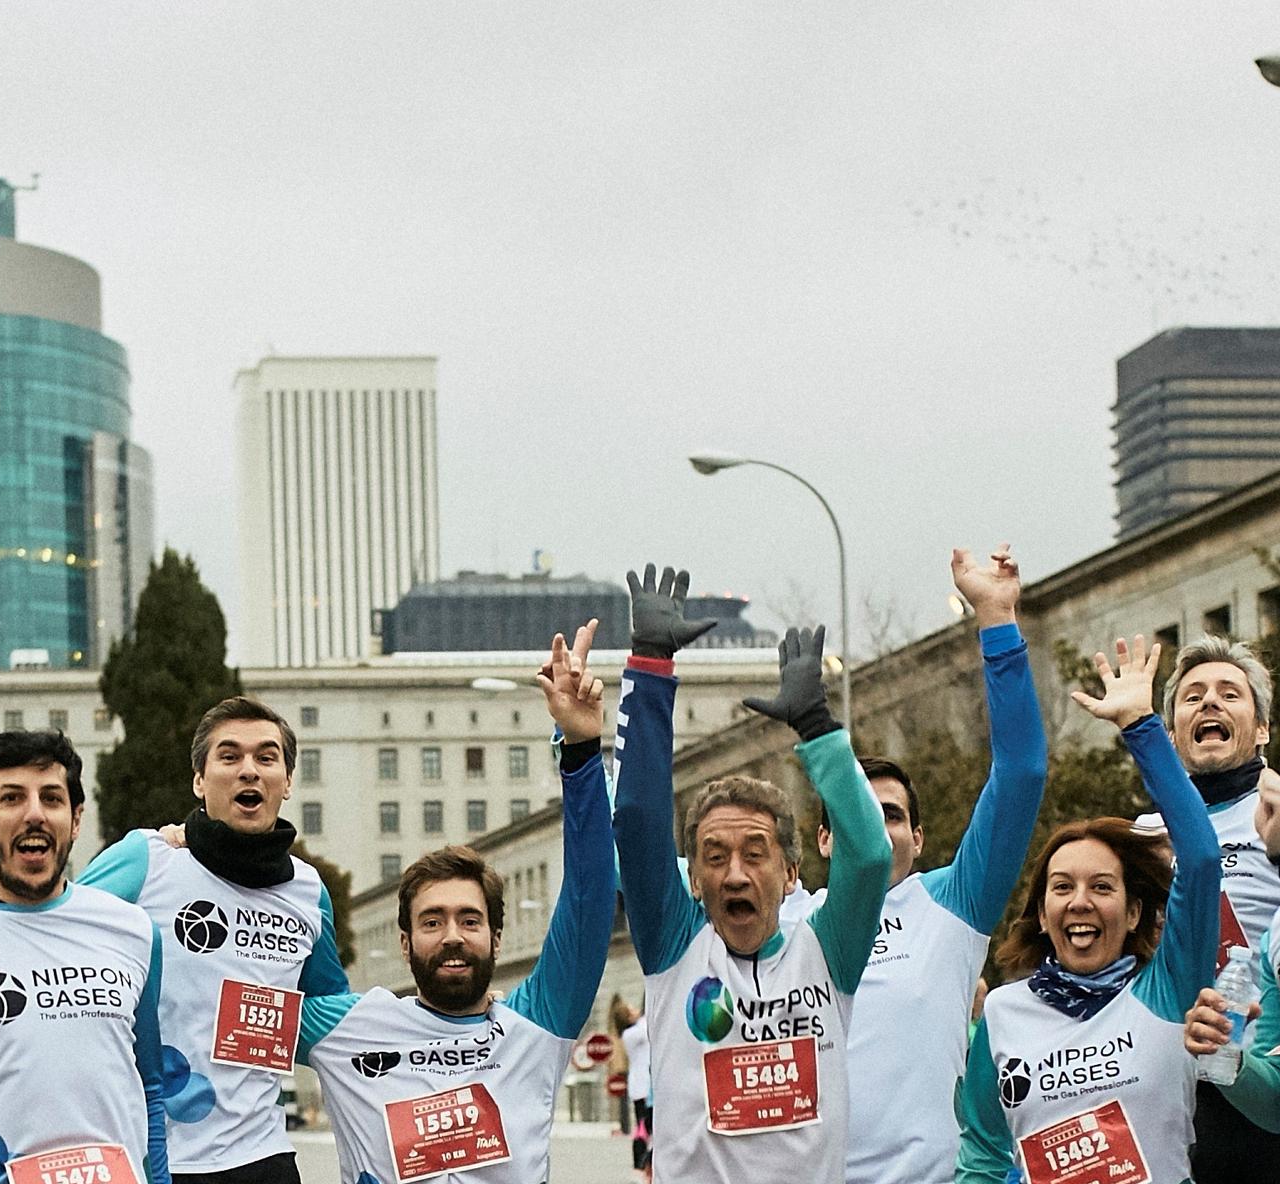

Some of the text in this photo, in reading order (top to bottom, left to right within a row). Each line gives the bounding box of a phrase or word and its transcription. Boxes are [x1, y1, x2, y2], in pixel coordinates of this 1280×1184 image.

[235, 907, 308, 936] NIPPON
[234, 929, 299, 954] GASES
[252, 951, 267, 961] Gas
[31, 966, 132, 990] NIPPON
[36, 988, 123, 1009] GASES
[737, 981, 832, 1021] NIPPON
[40, 1013, 58, 1021] The
[59, 1011, 79, 1020] Gas
[239, 1003, 284, 1030] 15521
[408, 1046, 491, 1067] GASES
[1038, 1031, 1134, 1072] NIPPON
[733, 1061, 799, 1089] 15484
[1040, 1060, 1121, 1092] GASES
[1042, 1075, 1140, 1102] The Gas Professionals
[415, 1105, 479, 1136] 15519
[441, 1151, 452, 1162] 10
[1045, 1131, 1110, 1172] 15482
